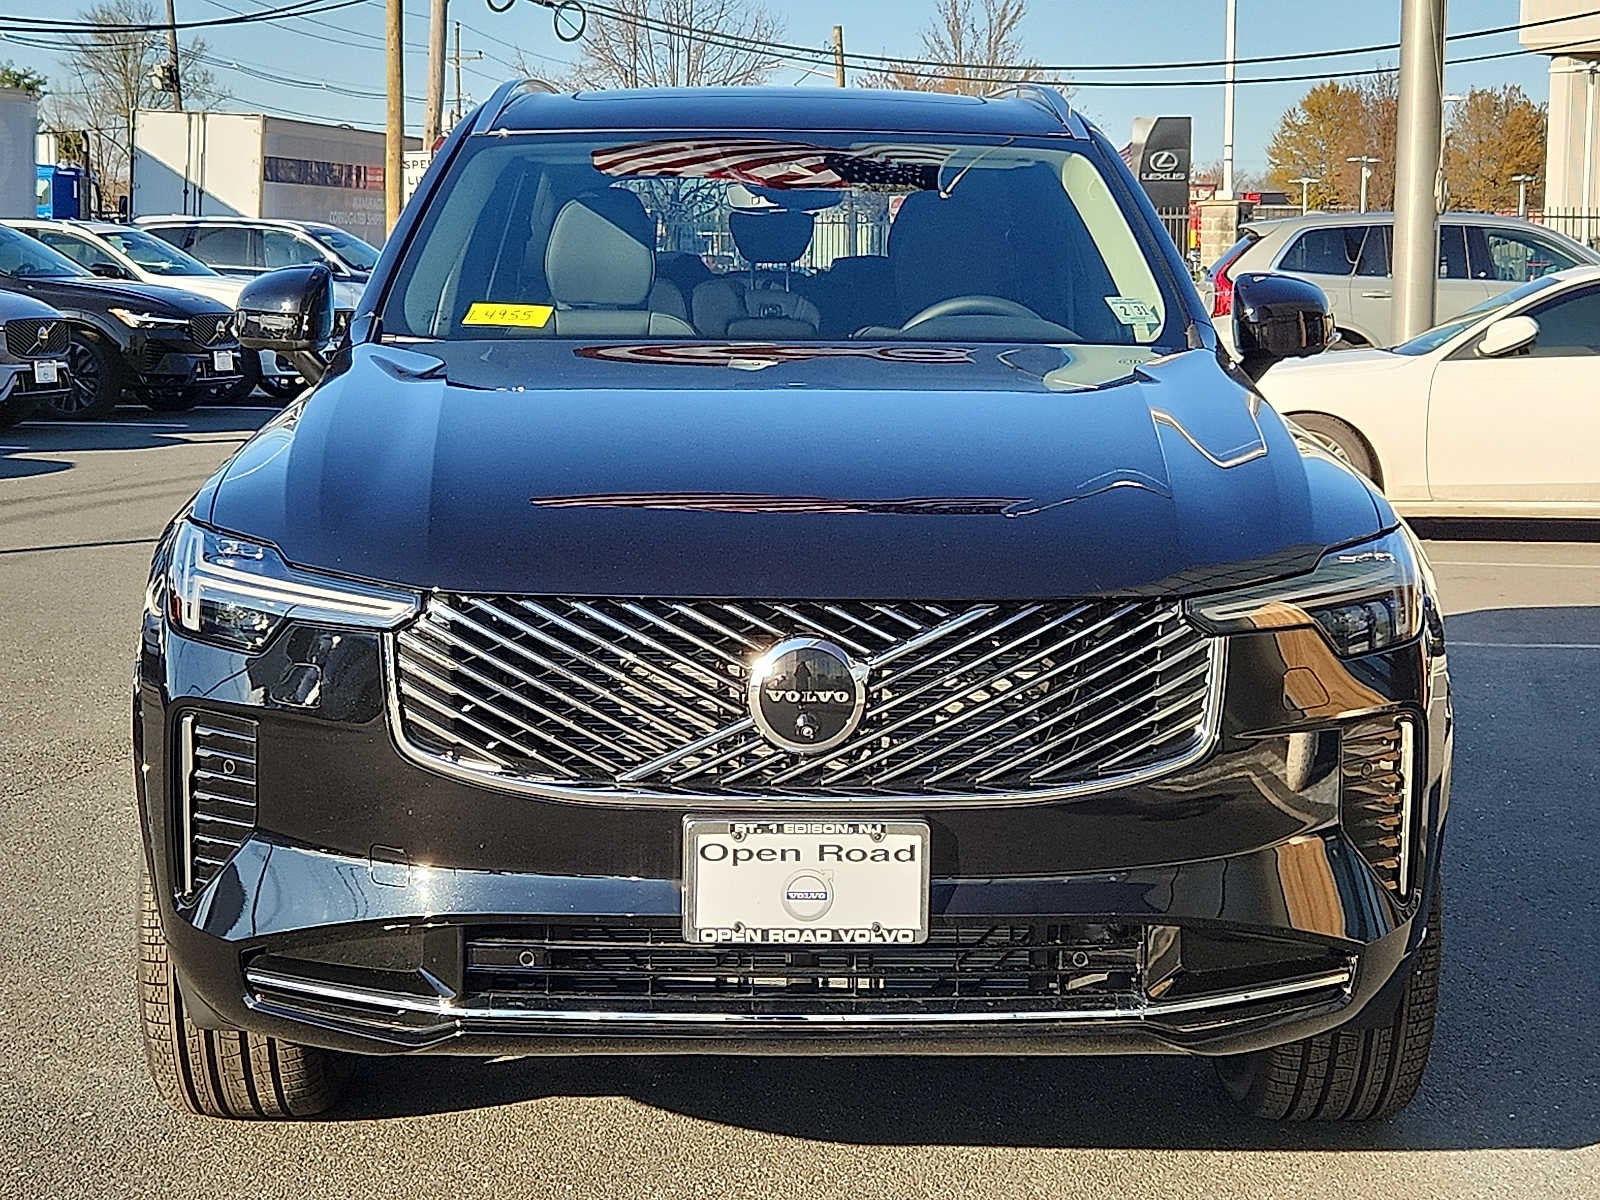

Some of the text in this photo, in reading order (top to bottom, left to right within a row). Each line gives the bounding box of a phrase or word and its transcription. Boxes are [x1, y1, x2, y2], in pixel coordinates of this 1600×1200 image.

[1141, 172, 1186, 180] LEXUS
[1119, 305, 1132, 316] 2
[765, 689, 850, 703] VOLVO
[768, 823, 778, 834] 1
[699, 843, 916, 866] Open Road
[700, 928, 915, 943] OPEN ROAD VOLVO
